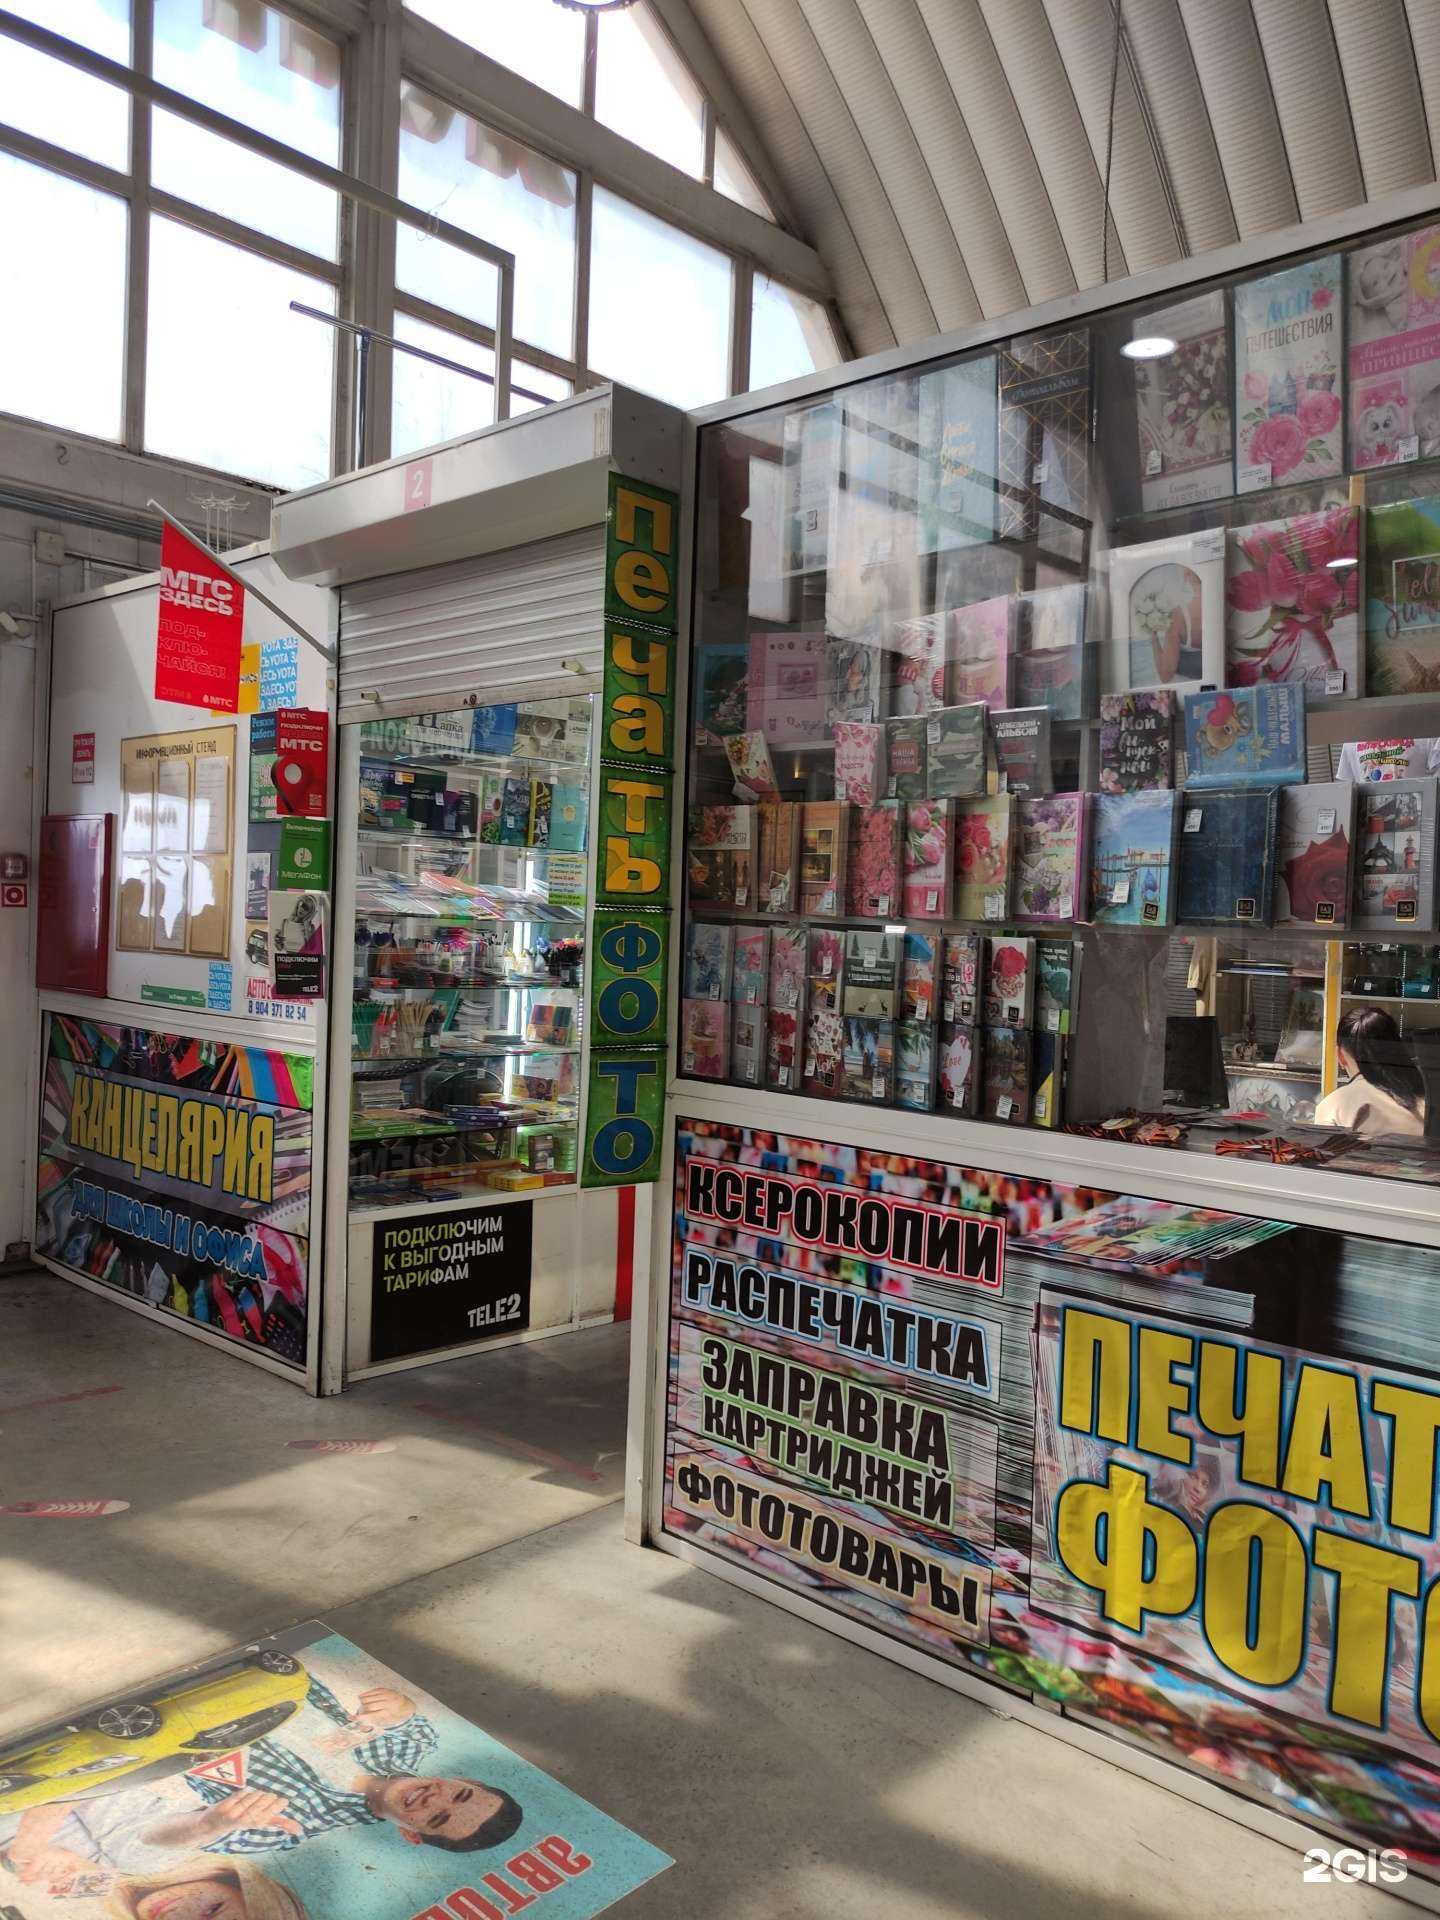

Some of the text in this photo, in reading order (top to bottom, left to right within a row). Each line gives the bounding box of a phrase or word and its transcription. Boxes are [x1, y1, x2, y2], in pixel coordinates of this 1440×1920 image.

[1247, 313, 1333, 353] ПУТЕШЕСТВИЯ
[411, 470, 424, 499] 2
[160, 566, 233, 600] МТС
[160, 587, 233, 616] ЗДЕСЬ
[136, 741, 193, 760] ИНФОРМАЦИОННЫЙ
[196, 740, 217, 753] СТЕНД
[280, 738, 323, 751] МТС
[70, 1073, 275, 1204] КАНЦЕЛЯРИЯ
[72, 1178, 104, 1224] ДЛЯ
[106, 1189, 172, 1252] ШКОЛЫ
[175, 1211, 190, 1257] И
[384, 1216, 503, 1249] ПОДКЛЮЧИМ
[686, 1162, 1001, 1287] КСЕРОКОПИИ
[384, 1236, 504, 1271] К ВЫГОДНЫМ
[383, 1263, 469, 1293] ТАРИФАМ
[467, 1293, 521, 1328] TELE2
[686, 1252, 992, 1390] РАСПЕЧАТКА
[702, 1339, 951, 1472] ЗАПРАВКА
[703, 1399, 953, 1528] КАРТРИДЖЕЙ
[677, 1461, 980, 1627] ФОТОТОВАРЫ
[1056, 1462, 1440, 1747] ФОТ
